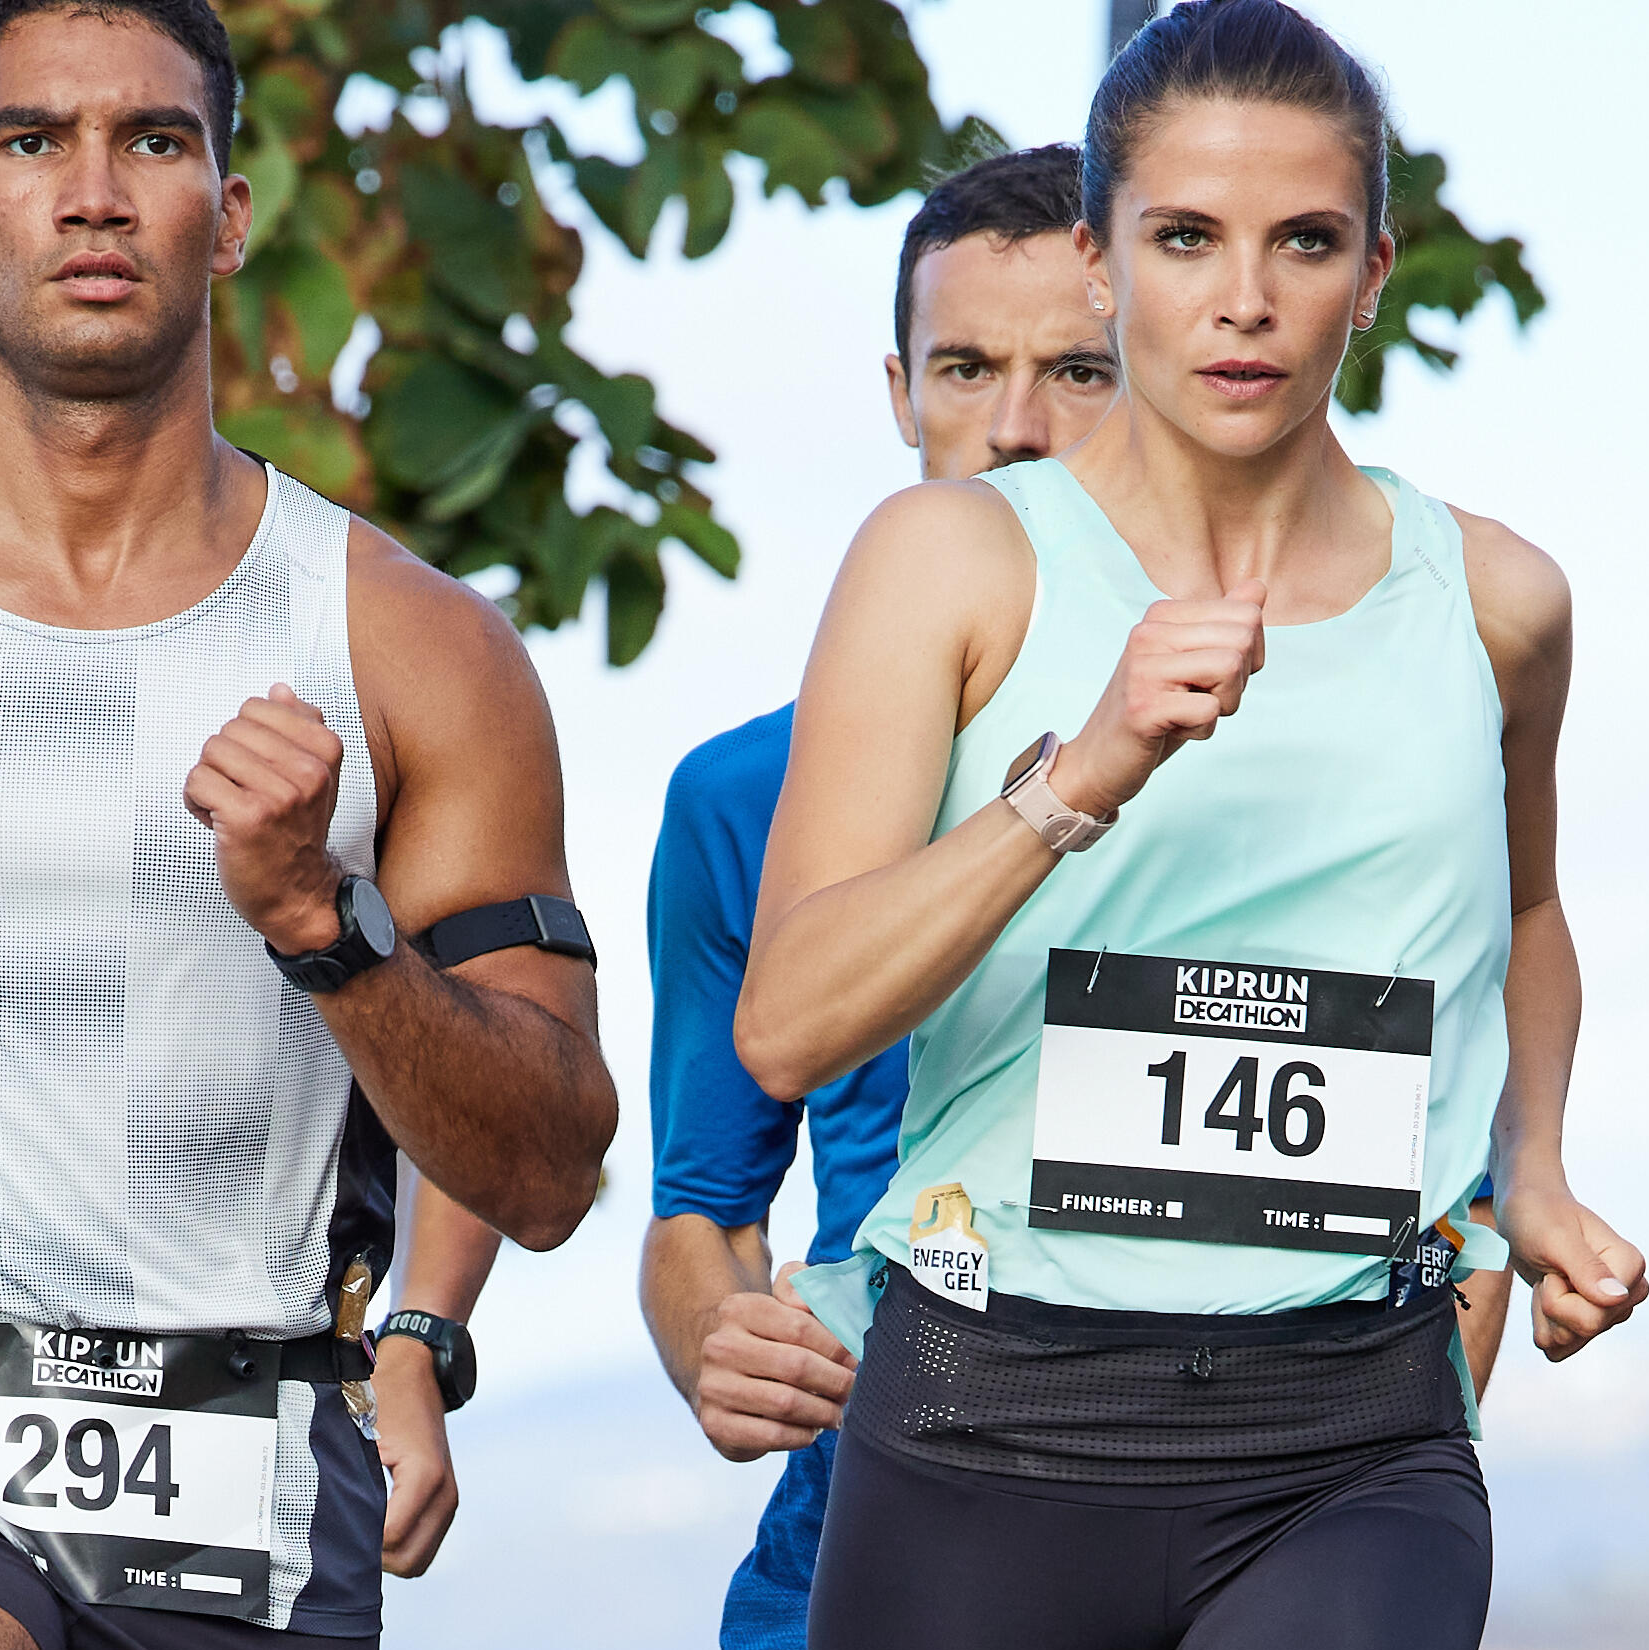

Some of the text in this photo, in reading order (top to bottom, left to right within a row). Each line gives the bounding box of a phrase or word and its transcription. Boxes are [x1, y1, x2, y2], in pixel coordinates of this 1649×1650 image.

[1175, 965, 1309, 1003] KIPRUN
[1179, 999, 1301, 1029] DECATHLON
[1146, 1050, 1326, 1158] 146
[913, 1247, 984, 1271] ENERGY
[944, 1271, 982, 1292] GEL
[33, 1329, 164, 1368] KIPUN
[37, 1362, 157, 1393] DECATHLON
[1, 1413, 180, 1517] 294
